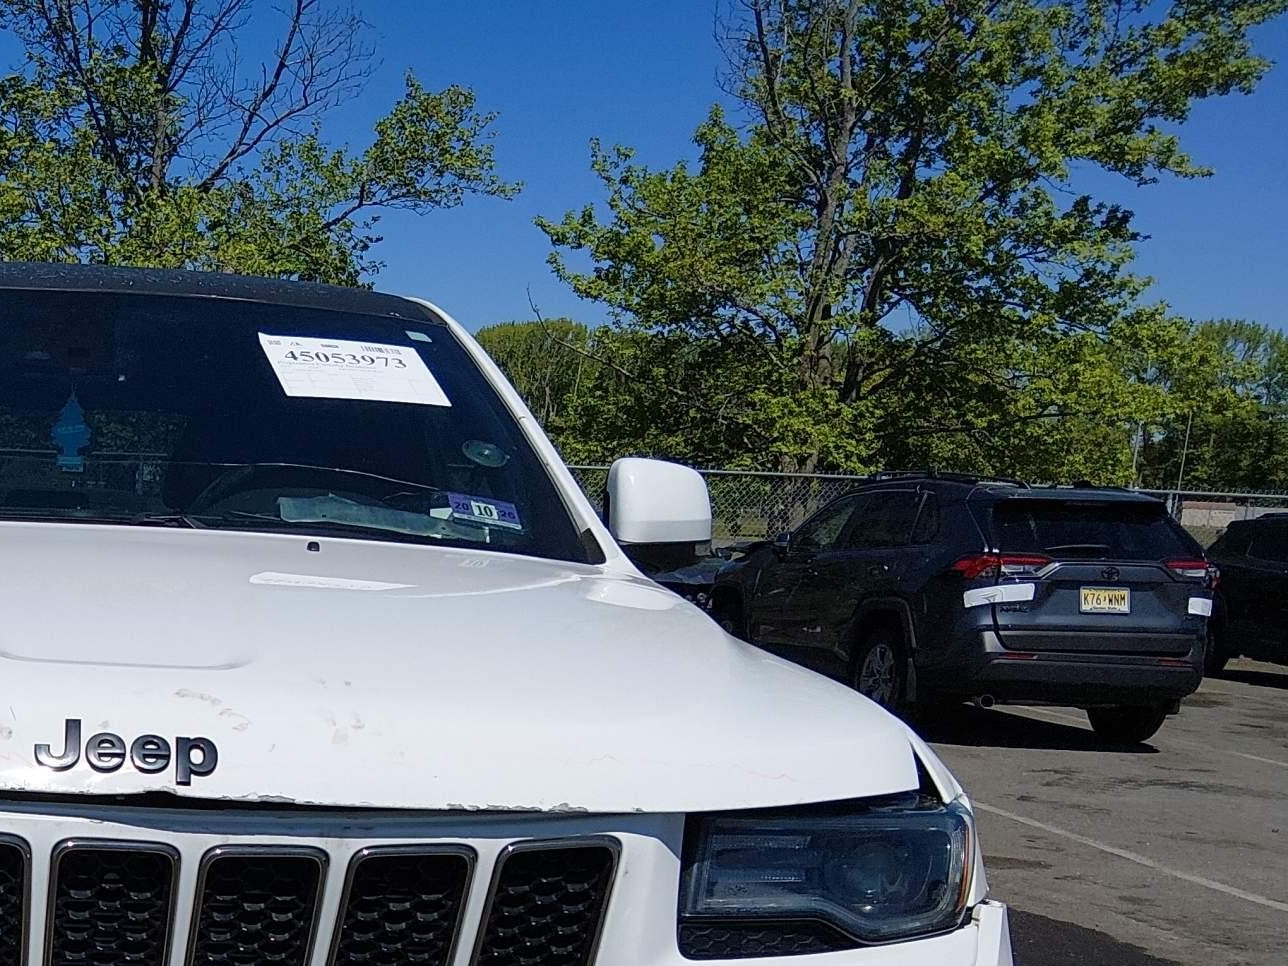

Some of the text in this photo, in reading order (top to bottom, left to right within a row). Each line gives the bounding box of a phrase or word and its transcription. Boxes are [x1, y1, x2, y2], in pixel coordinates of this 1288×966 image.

[284, 350, 407, 369] 45053973
[453, 501, 470, 512] 20
[475, 504, 493, 518] 10
[34, 718, 219, 787] Jeep
